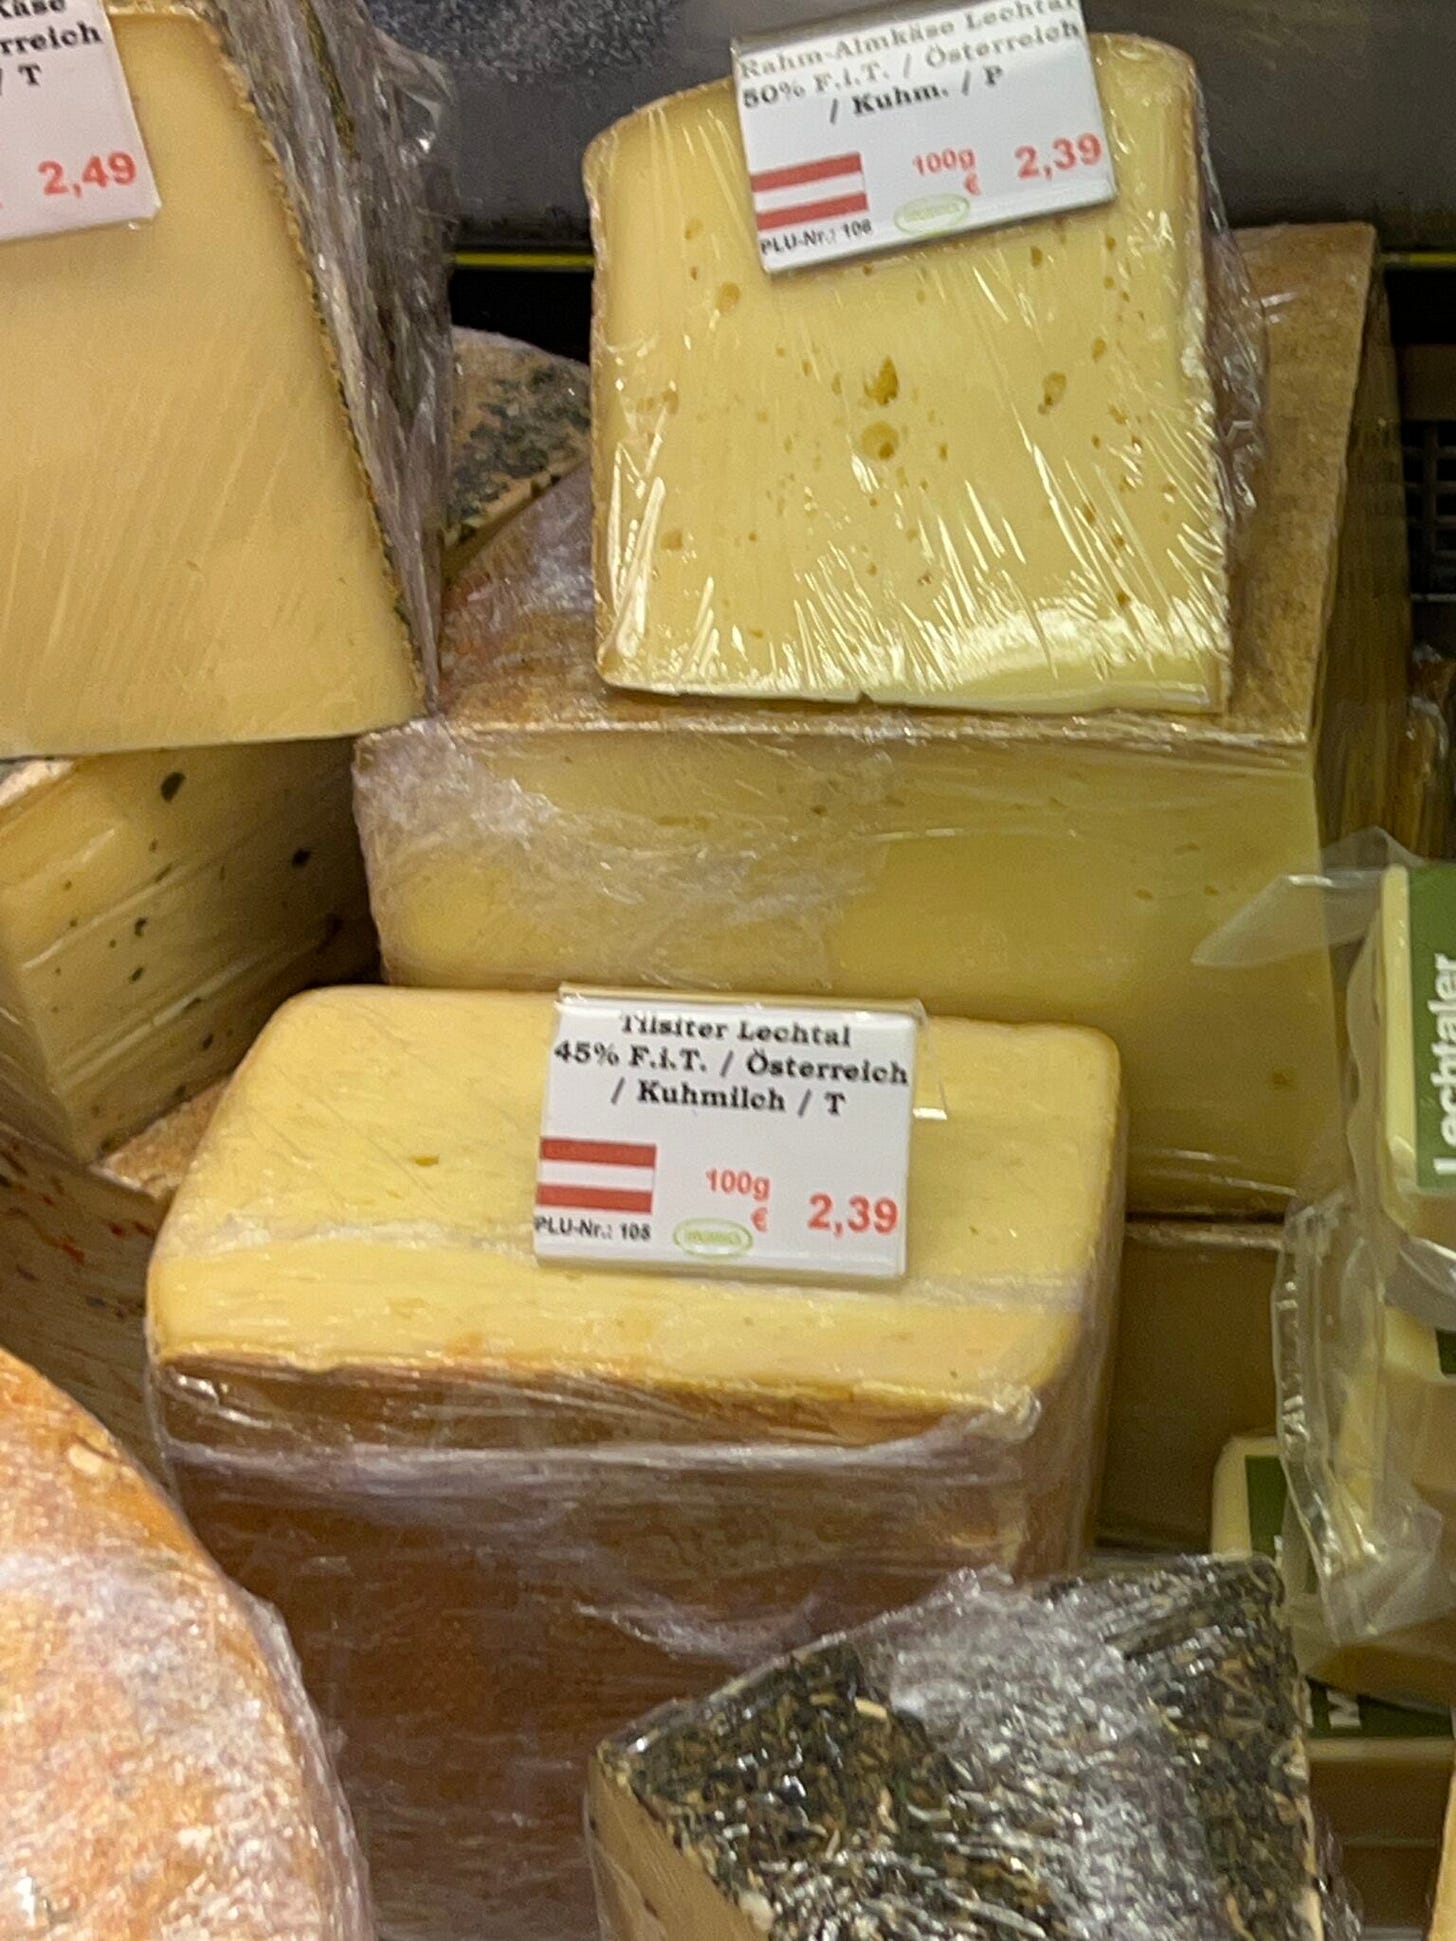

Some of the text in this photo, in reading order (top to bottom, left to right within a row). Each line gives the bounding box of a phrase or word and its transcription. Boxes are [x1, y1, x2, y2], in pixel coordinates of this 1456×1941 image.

[739, 20, 955, 80] Rahm-Almkäse
[743, 79, 806, 110] 50%
[925, 19, 1081, 69] Österreich
[18, 63, 42, 86] T
[852, 82, 949, 117] Kuhm.
[984, 65, 1003, 87] P
[37, 151, 137, 198] 2,49
[912, 147, 976, 176] 100g
[1014, 132, 1102, 181] 2,39
[621, 1012, 851, 1047] Tilsiter Lechtal
[554, 1040, 910, 1086] 45% F.i.T. / Österreich
[611, 1077, 846, 1118] / Kuhmilch / T
[706, 1168, 771, 1201] 100g
[750, 1193, 899, 1238] € 2,39
